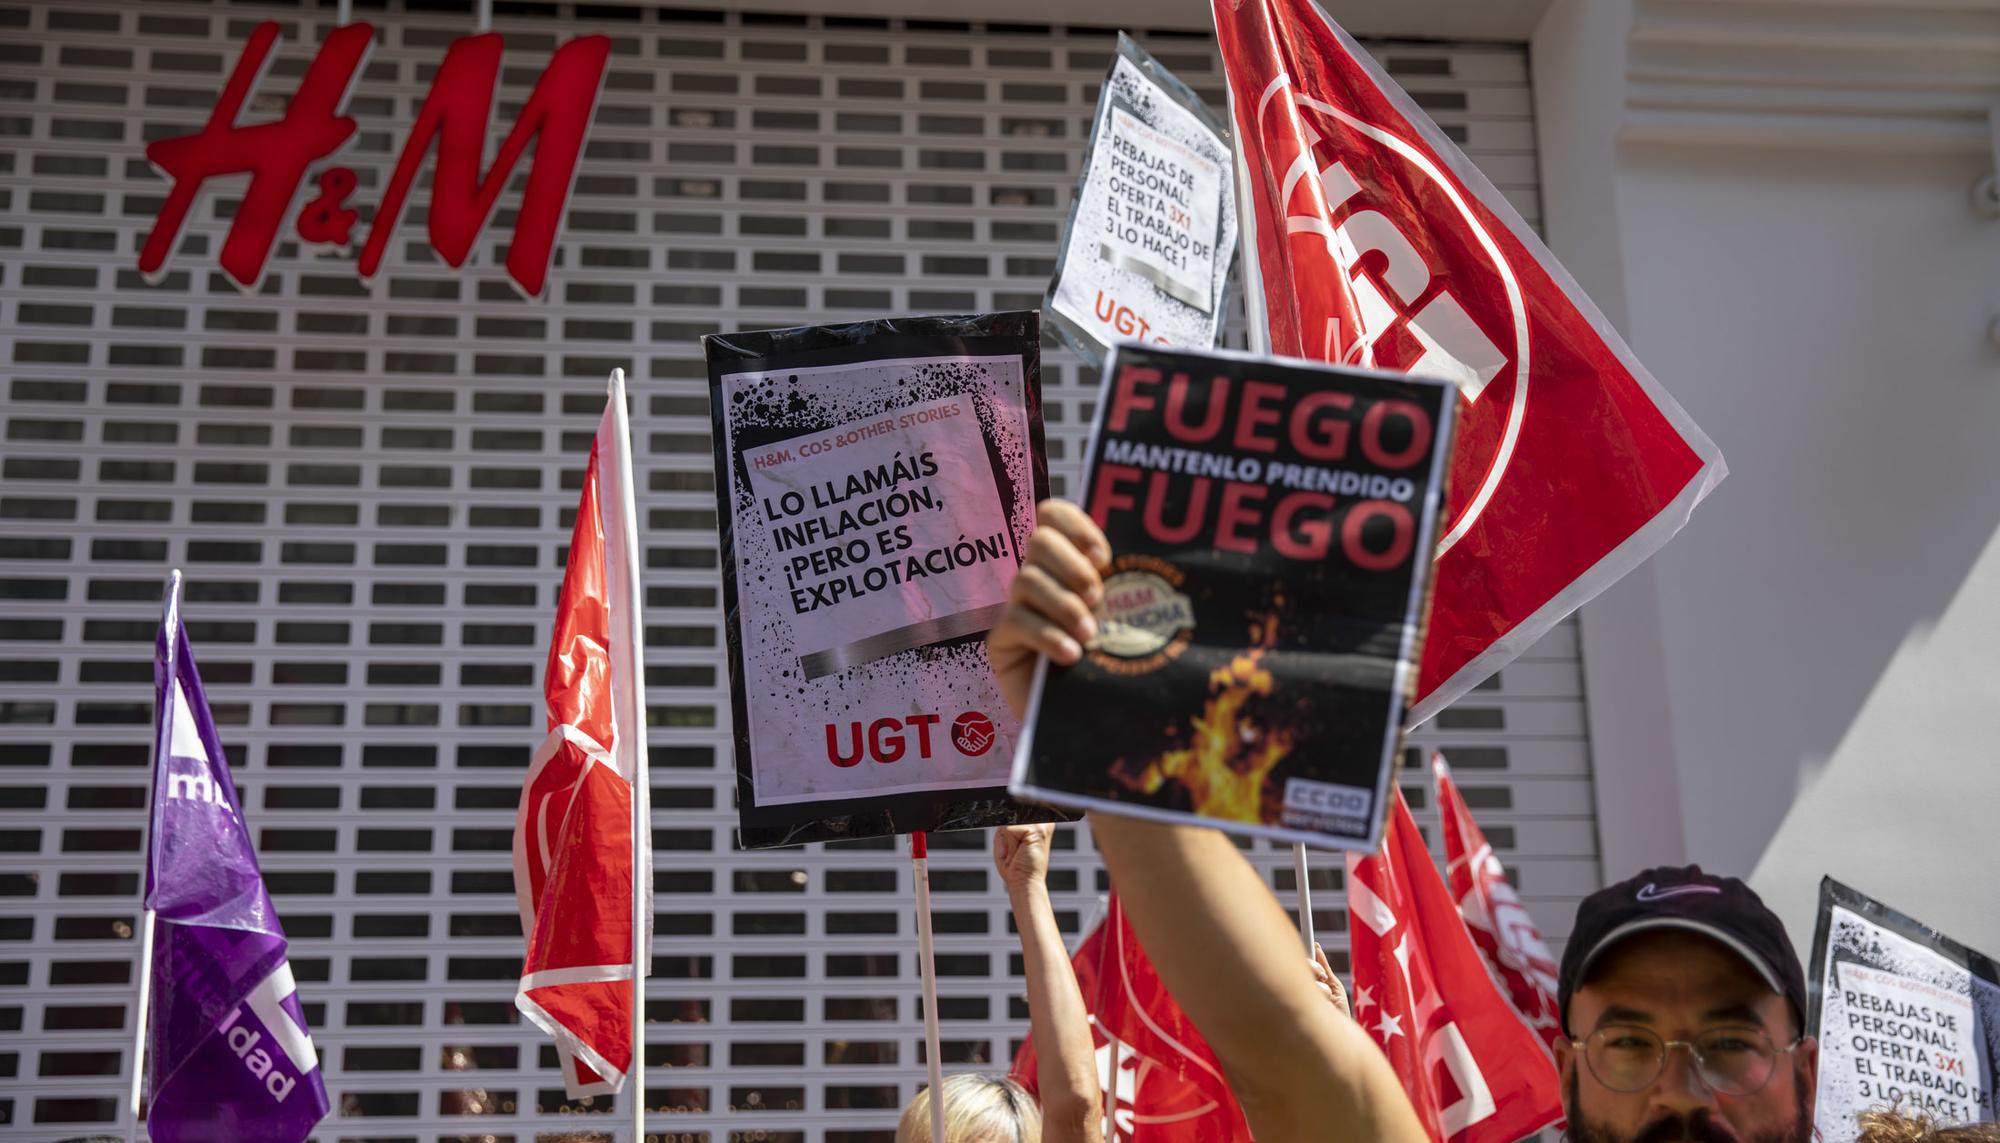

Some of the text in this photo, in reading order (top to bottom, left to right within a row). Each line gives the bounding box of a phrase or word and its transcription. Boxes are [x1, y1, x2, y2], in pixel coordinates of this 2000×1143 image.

[138, 20, 612, 297] H&M
[1113, 135, 1176, 178] REBAJAS
[1179, 169, 1194, 191] DE
[1108, 196, 1210, 261] EL TRABAJO DE
[1109, 177, 1191, 231] OFERTA 3X1
[1106, 217, 1115, 233] 3
[1118, 223, 1138, 244] LO
[1143, 234, 1178, 266] HACE
[1095, 289, 1151, 342] UGT
[754, 403, 961, 470] H&M, COS &OTHER STORIES
[1107, 365, 1431, 469] FUEGO
[764, 451, 938, 522] LO LLAMÁIS
[1104, 438, 1414, 502] MANTENLO PRENDIDO
[773, 485, 943, 552] INFLACIÓN,
[1091, 464, 1415, 571] FUEGO
[784, 525, 913, 590] ¡PERO ES
[790, 533, 1009, 615] EXPLOTACIÓN!
[825, 714, 940, 768] UGT
[1845, 990, 1957, 1032] REBAJAS DE
[1848, 1013, 1957, 1053] PERSONAL:
[1852, 1035, 1964, 1077] OFERTA 3X1
[1855, 1058, 1989, 1108] EL TRABAJO DE
[1860, 1080, 1970, 1121] 3 LO HACE 1
